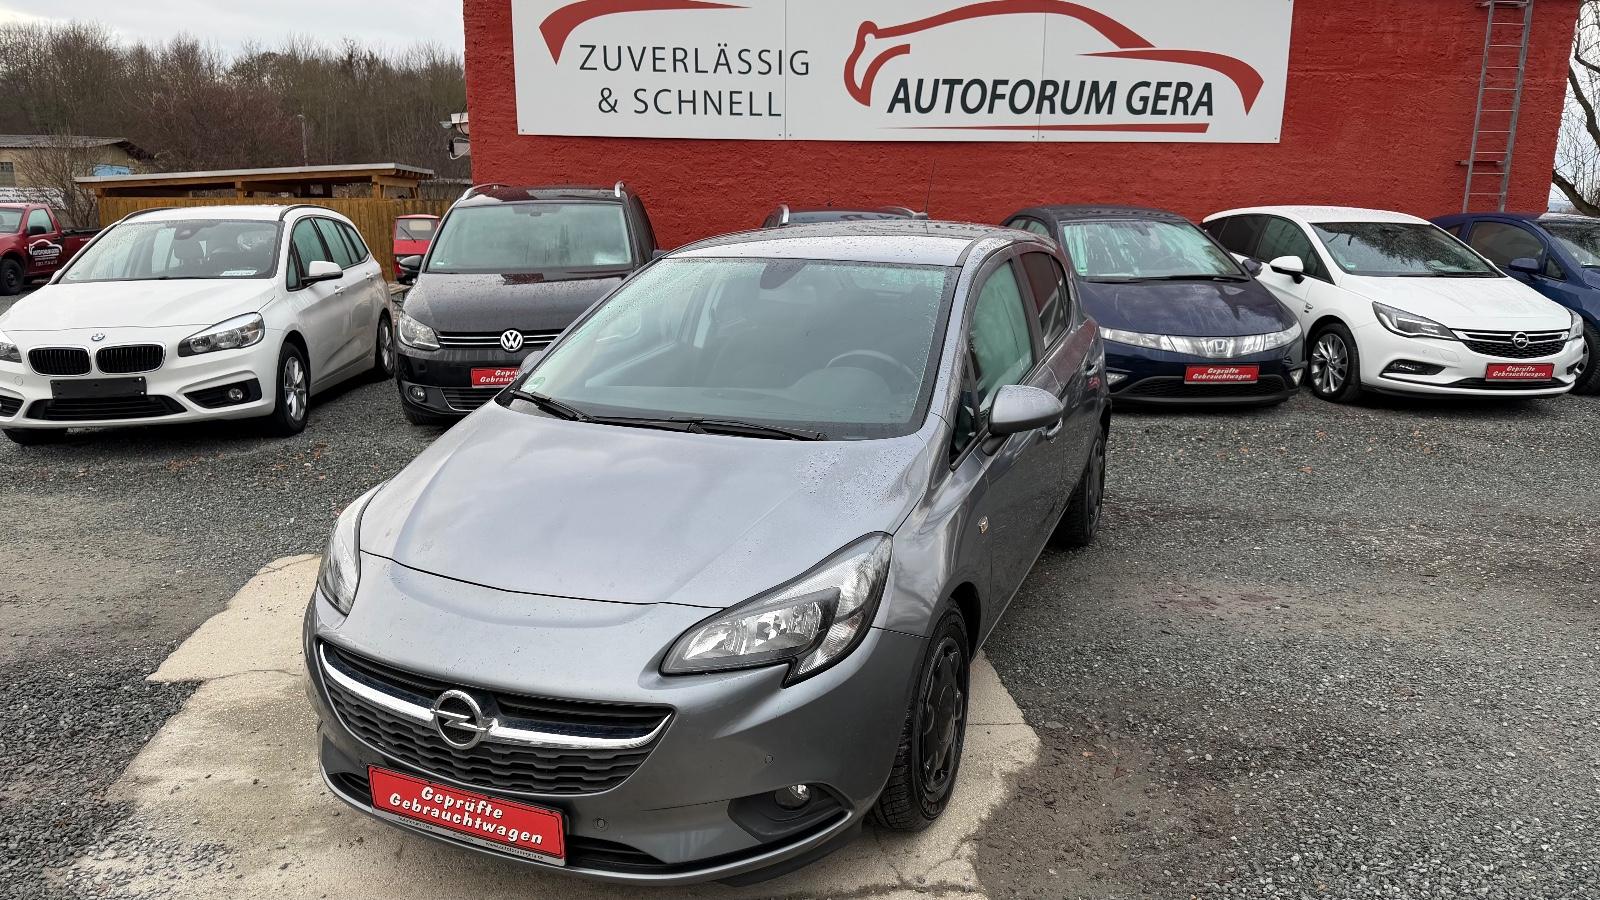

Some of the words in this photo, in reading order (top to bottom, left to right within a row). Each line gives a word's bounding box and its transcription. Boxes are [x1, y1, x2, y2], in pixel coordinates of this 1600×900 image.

[579, 43, 810, 76] ZUVERLÄSSIG
[598, 87, 619, 114] &
[633, 88, 782, 117] SCHNELL
[886, 77, 1118, 115] AUTOFORUM
[1125, 81, 1214, 116] GERA
[495, 369, 519, 377] Geprü
[1192, 373, 1252, 381] Gebrauchtwagen
[1207, 367, 1240, 375] Geprüfte
[389, 792, 544, 845] Gebrauchtwagen
[421, 786, 504, 820] Geprüfte
